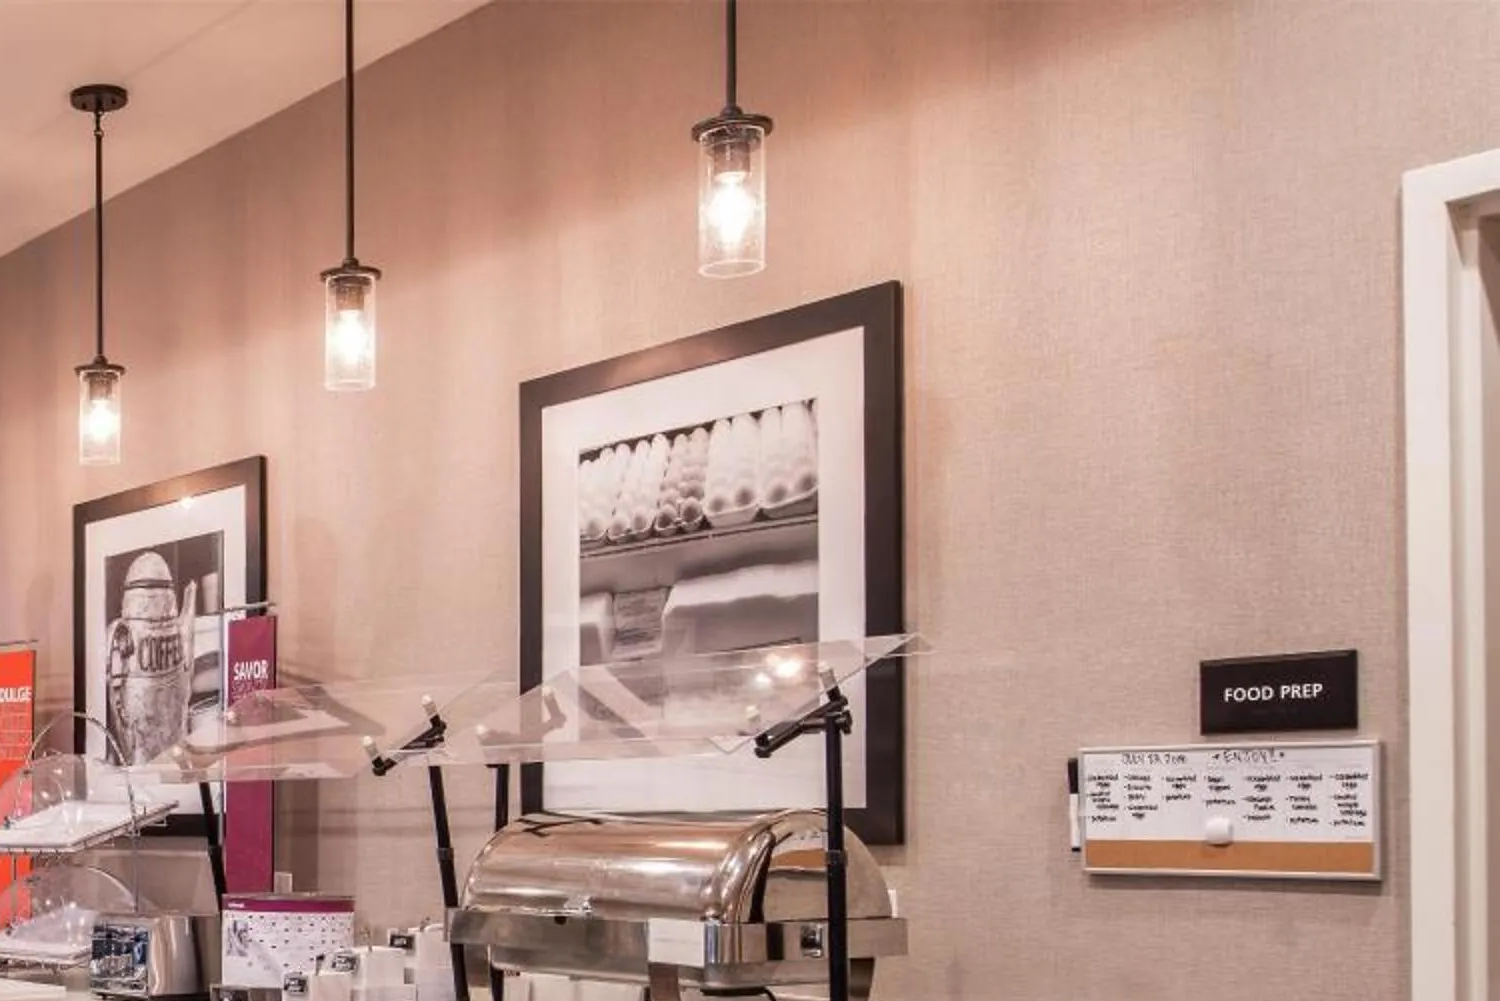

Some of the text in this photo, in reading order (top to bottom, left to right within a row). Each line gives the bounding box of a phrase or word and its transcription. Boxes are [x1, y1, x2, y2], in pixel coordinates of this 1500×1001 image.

[233, 659, 269, 681] SAVOR
[1224, 683, 1323, 702] FOOD PREP
